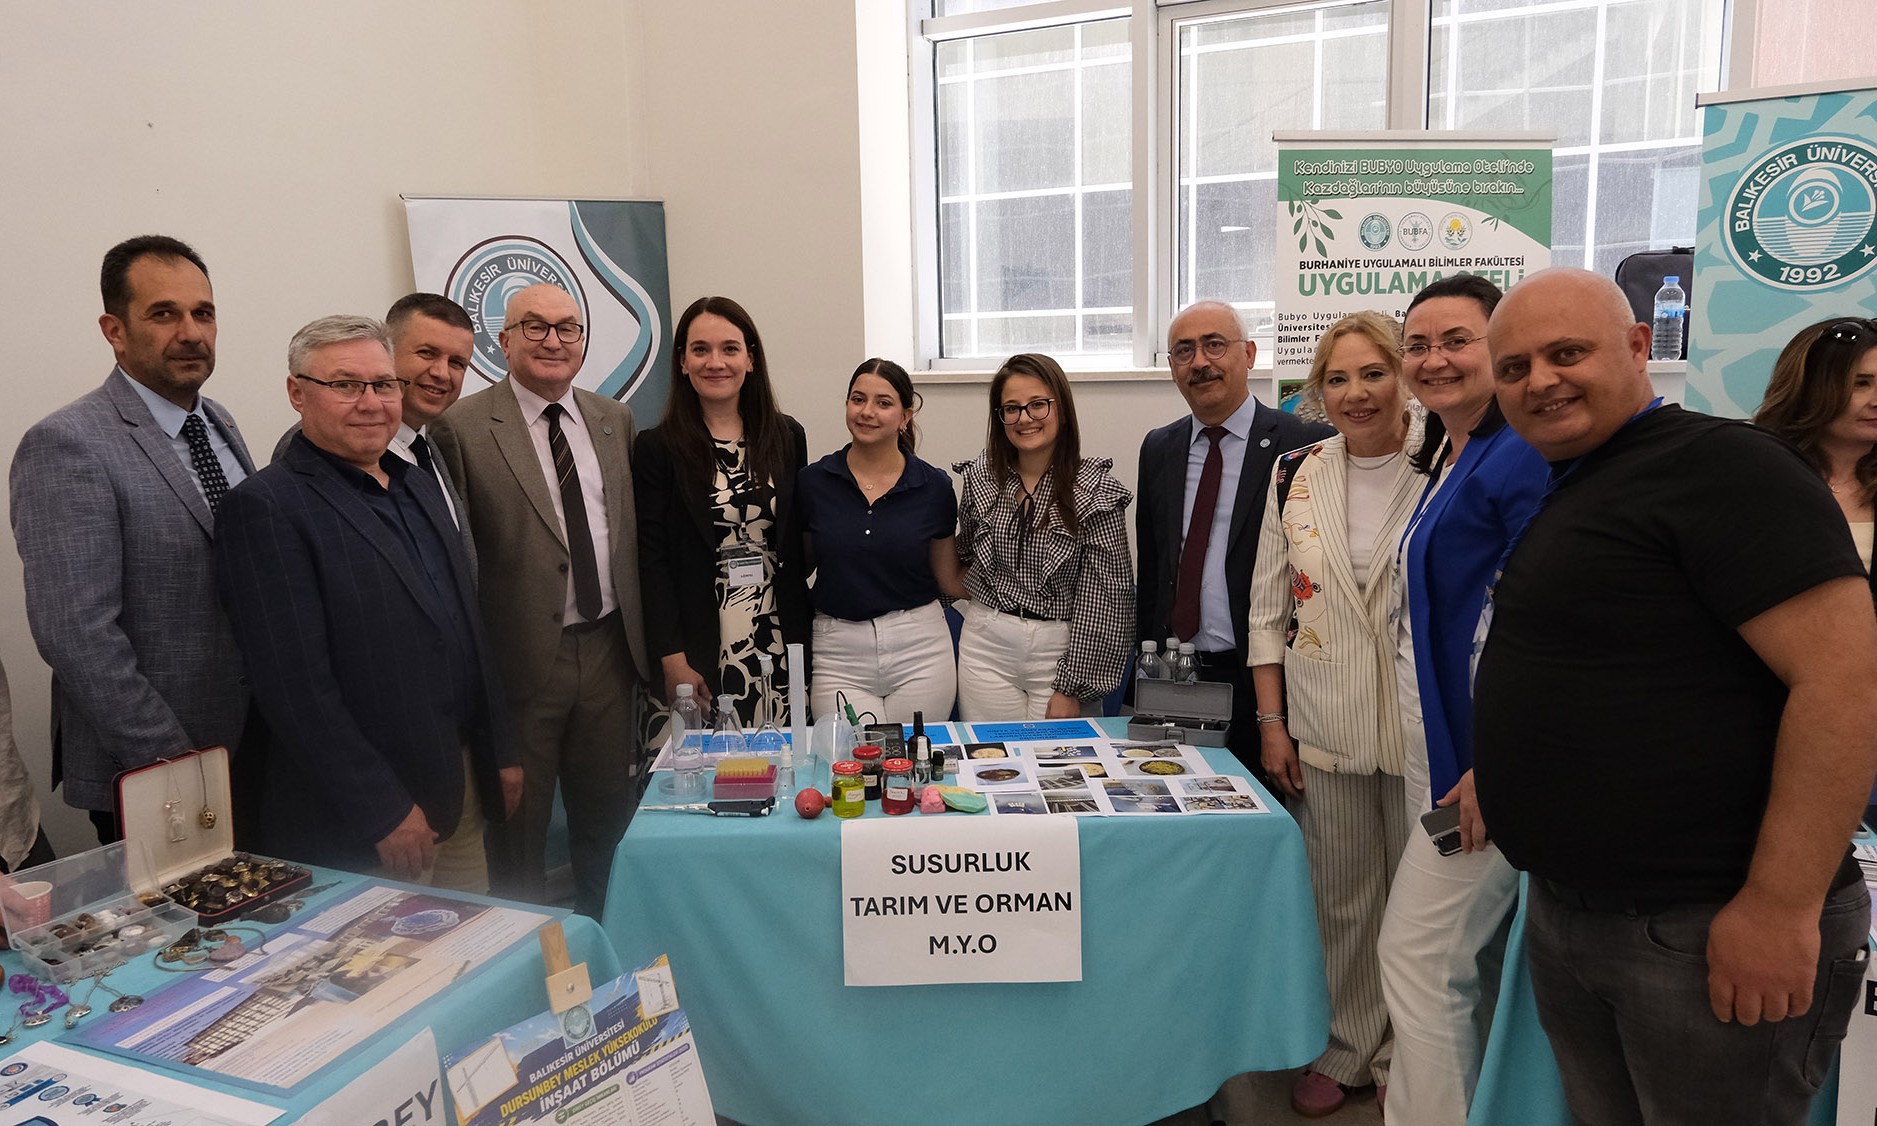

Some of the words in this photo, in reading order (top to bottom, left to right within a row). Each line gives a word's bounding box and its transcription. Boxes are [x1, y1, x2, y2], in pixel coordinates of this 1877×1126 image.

[1294, 160, 1359, 176] Kendinizi
[1360, 160, 1404, 175] BUBYO
[1405, 159, 1472, 178] Uygulama
[1404, 179, 1471, 197] büyüsüne
[1735, 151, 1798, 232] BALIKESİR
[1807, 144, 1877, 188] ÜNİVERS
[1403, 228, 1428, 236] BUBFA
[1299, 258, 1360, 270] BURHANİYE
[1363, 257, 1426, 269] UYGULAMALI
[1428, 255, 1472, 267] BİLİMLER
[1475, 255, 1524, 266] FAKÜLTESİ
[1779, 263, 1841, 284] 1992
[467, 263, 502, 334] BALIKESİR
[1278, 312, 1307, 321] Bubyo
[1277, 335, 1310, 343] Bilimler
[891, 851, 1031, 875] SUSURLUK
[850, 894, 928, 917] TARIM
[936, 894, 968, 914] VE
[975, 891, 1072, 913] ORMAN
[929, 934, 997, 955] M.Y.O
[529, 1052, 574, 1083] BALIKESİR
[575, 1018, 625, 1056] ÜNİVERSİTESİ
[500, 1075, 562, 1118] DURSUNBEY
[563, 1050, 602, 1082] MESLEK
[539, 1074, 588, 1113] İNŞAAT
[590, 1040, 641, 1082] BÖLÜMÜ
[373, 1078, 438, 1126] EY
